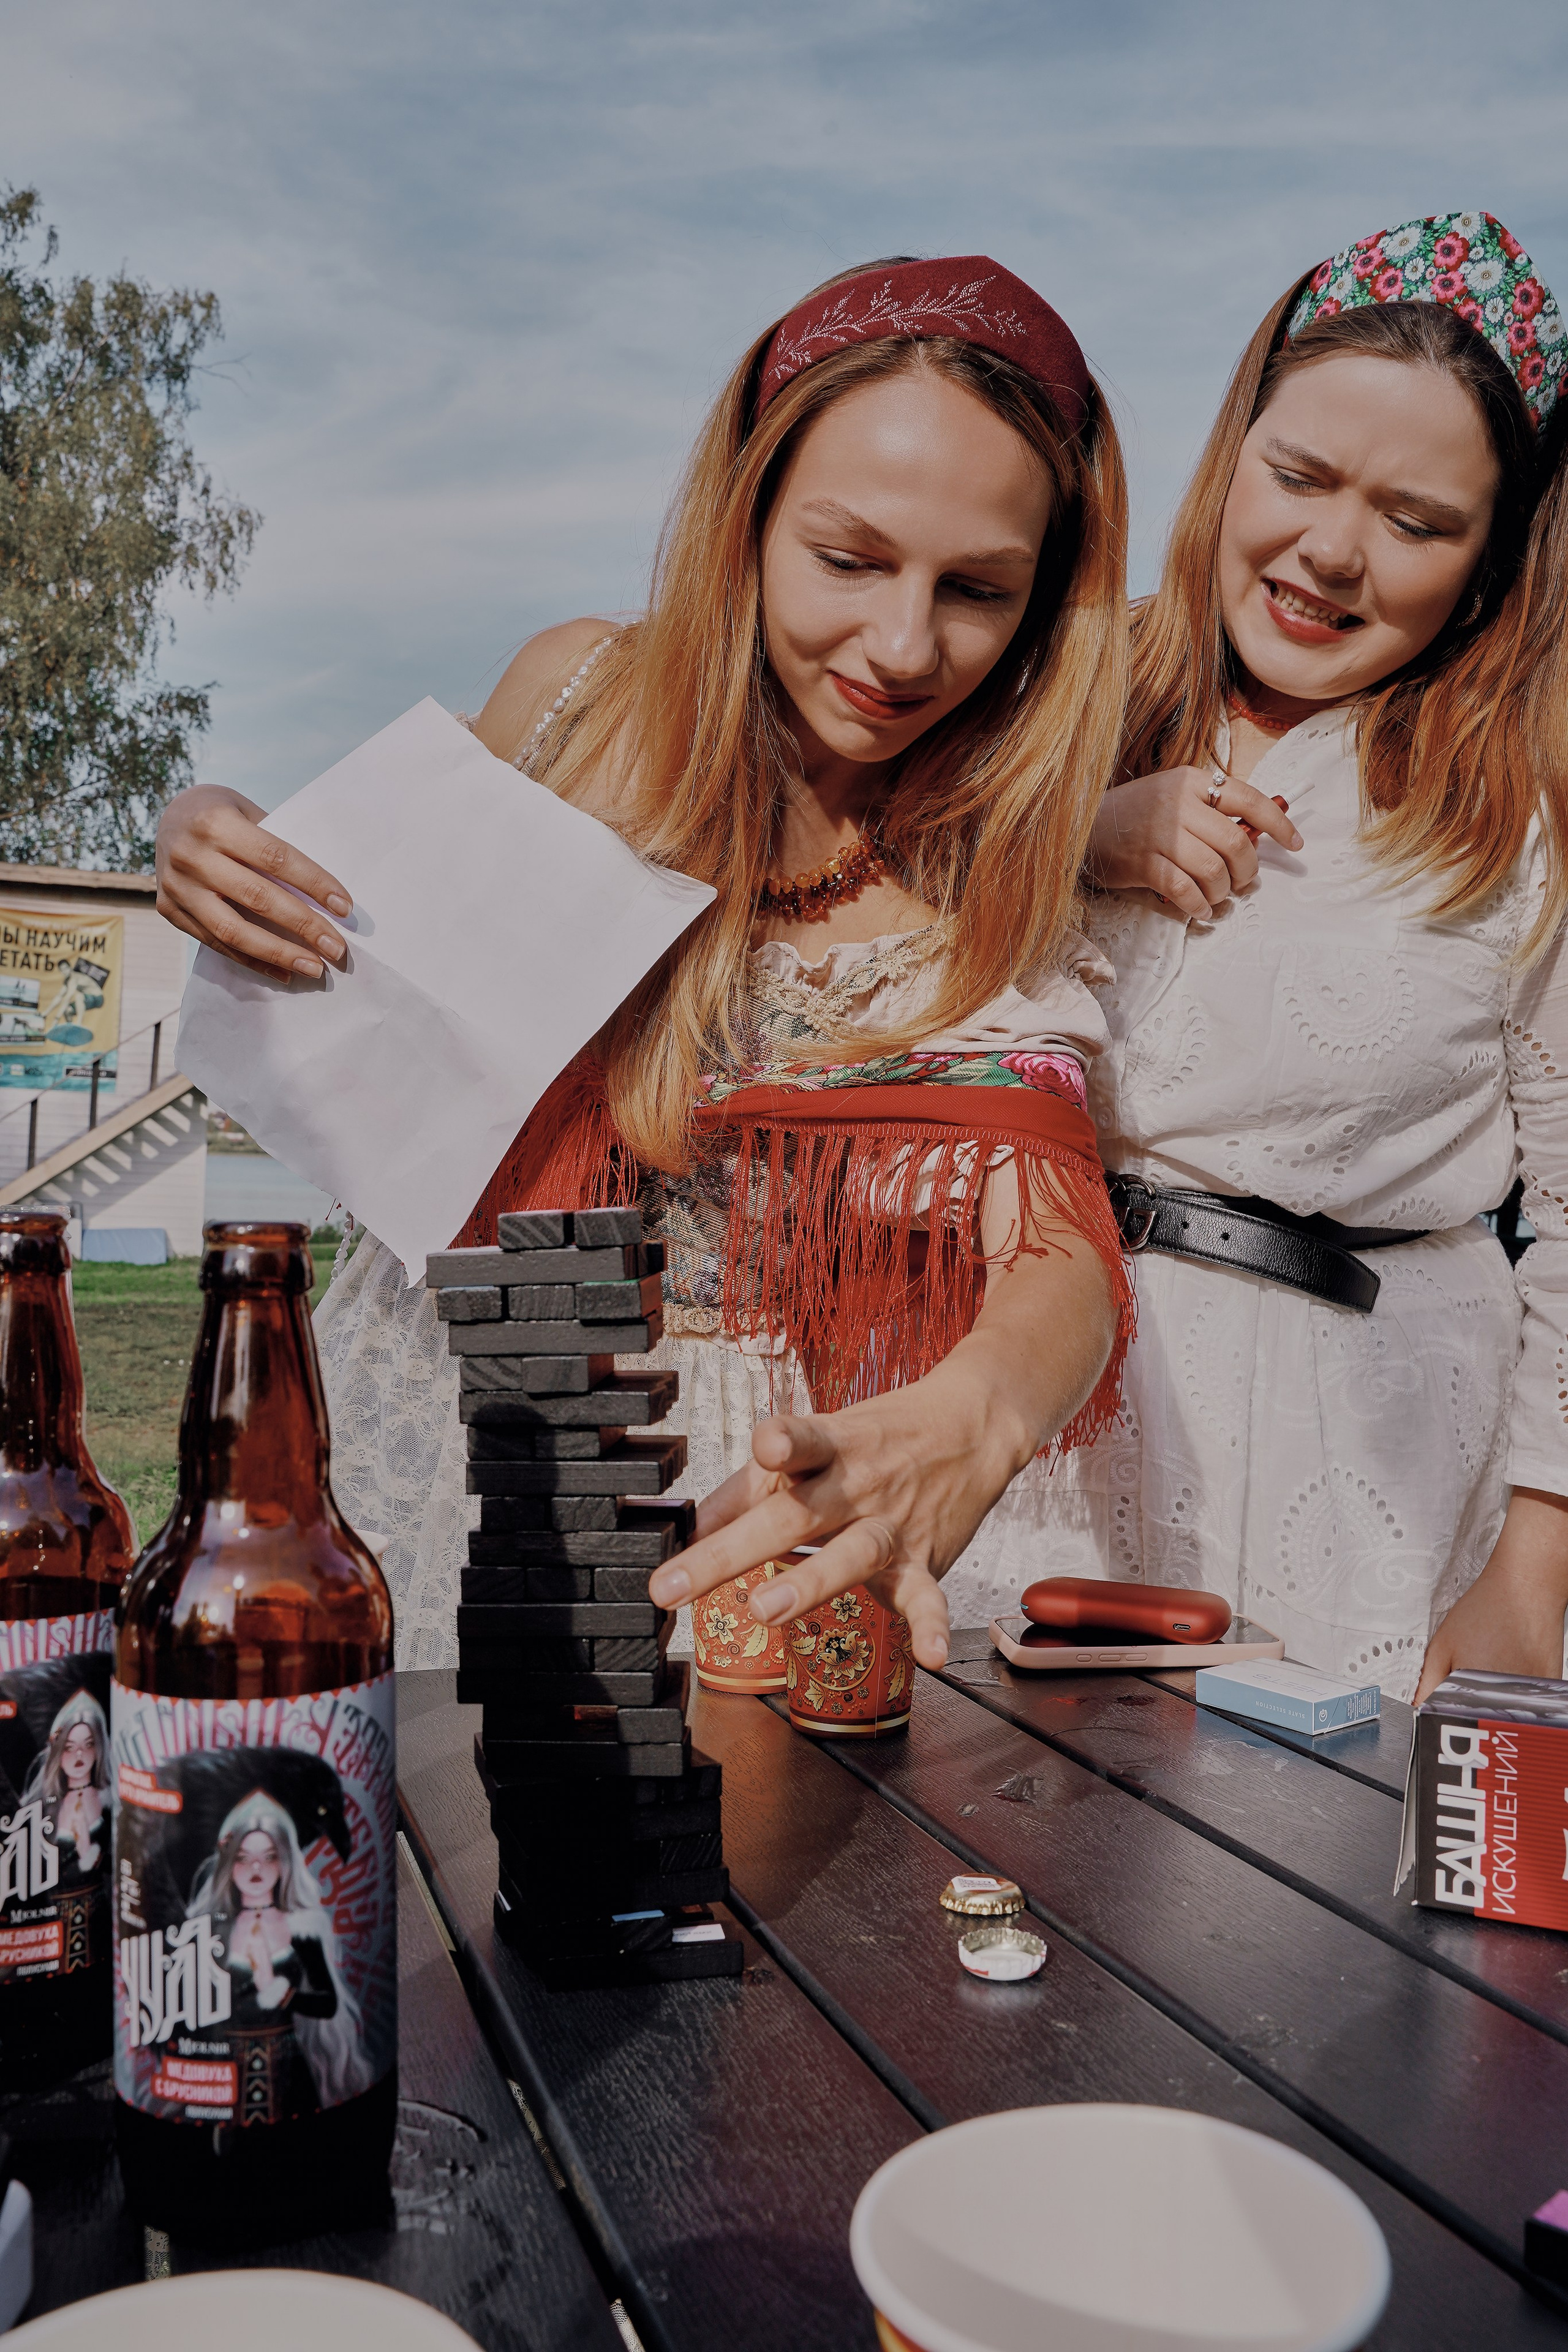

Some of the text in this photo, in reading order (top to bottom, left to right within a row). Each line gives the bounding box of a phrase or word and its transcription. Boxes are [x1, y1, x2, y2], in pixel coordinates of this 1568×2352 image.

[0, 926, 106, 953] Ы НАУЧИМ
[1252, 1673, 1329, 1696] HEETS
[1255, 1700, 1305, 1719] SLATE SELECTION
[1435, 1724, 1489, 1909] БАШНЯ
[1492, 1731, 1518, 1914] ИСКУШЕНИЙ
[0, 1940, 59, 1964] РУСНИКОЙ
